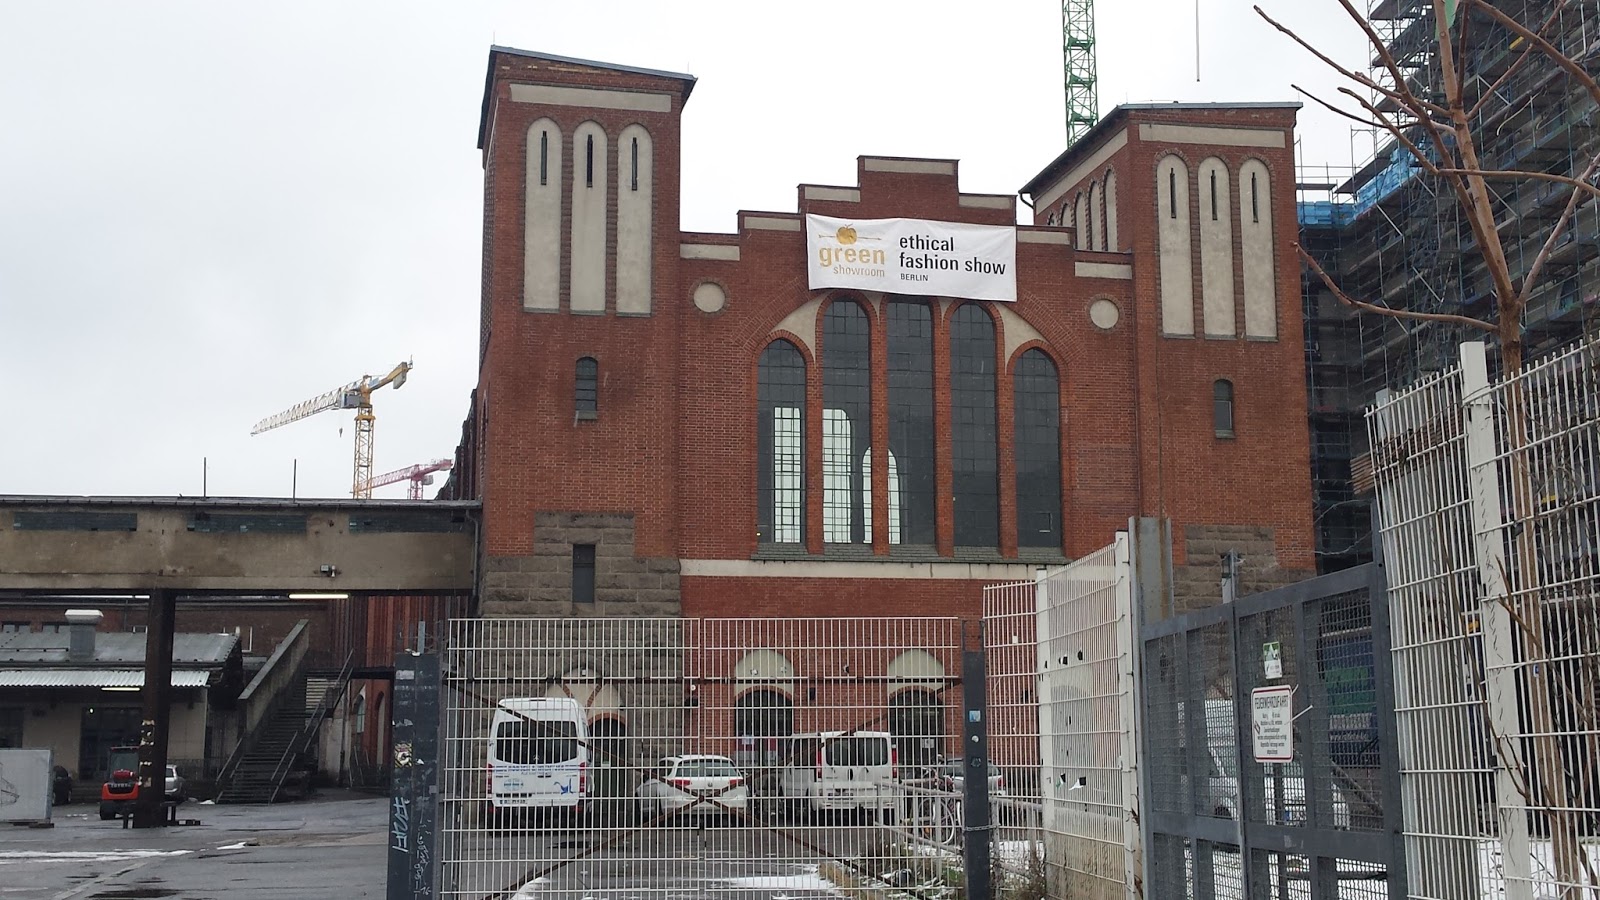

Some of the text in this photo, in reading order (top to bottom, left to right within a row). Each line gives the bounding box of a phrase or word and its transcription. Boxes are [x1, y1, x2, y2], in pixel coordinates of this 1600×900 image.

[899, 234, 954, 251] ethical
[818, 246, 885, 267] green
[899, 252, 1006, 275] fashion show
[833, 264, 885, 278] showroom
[900, 273, 929, 282] BERLIN
